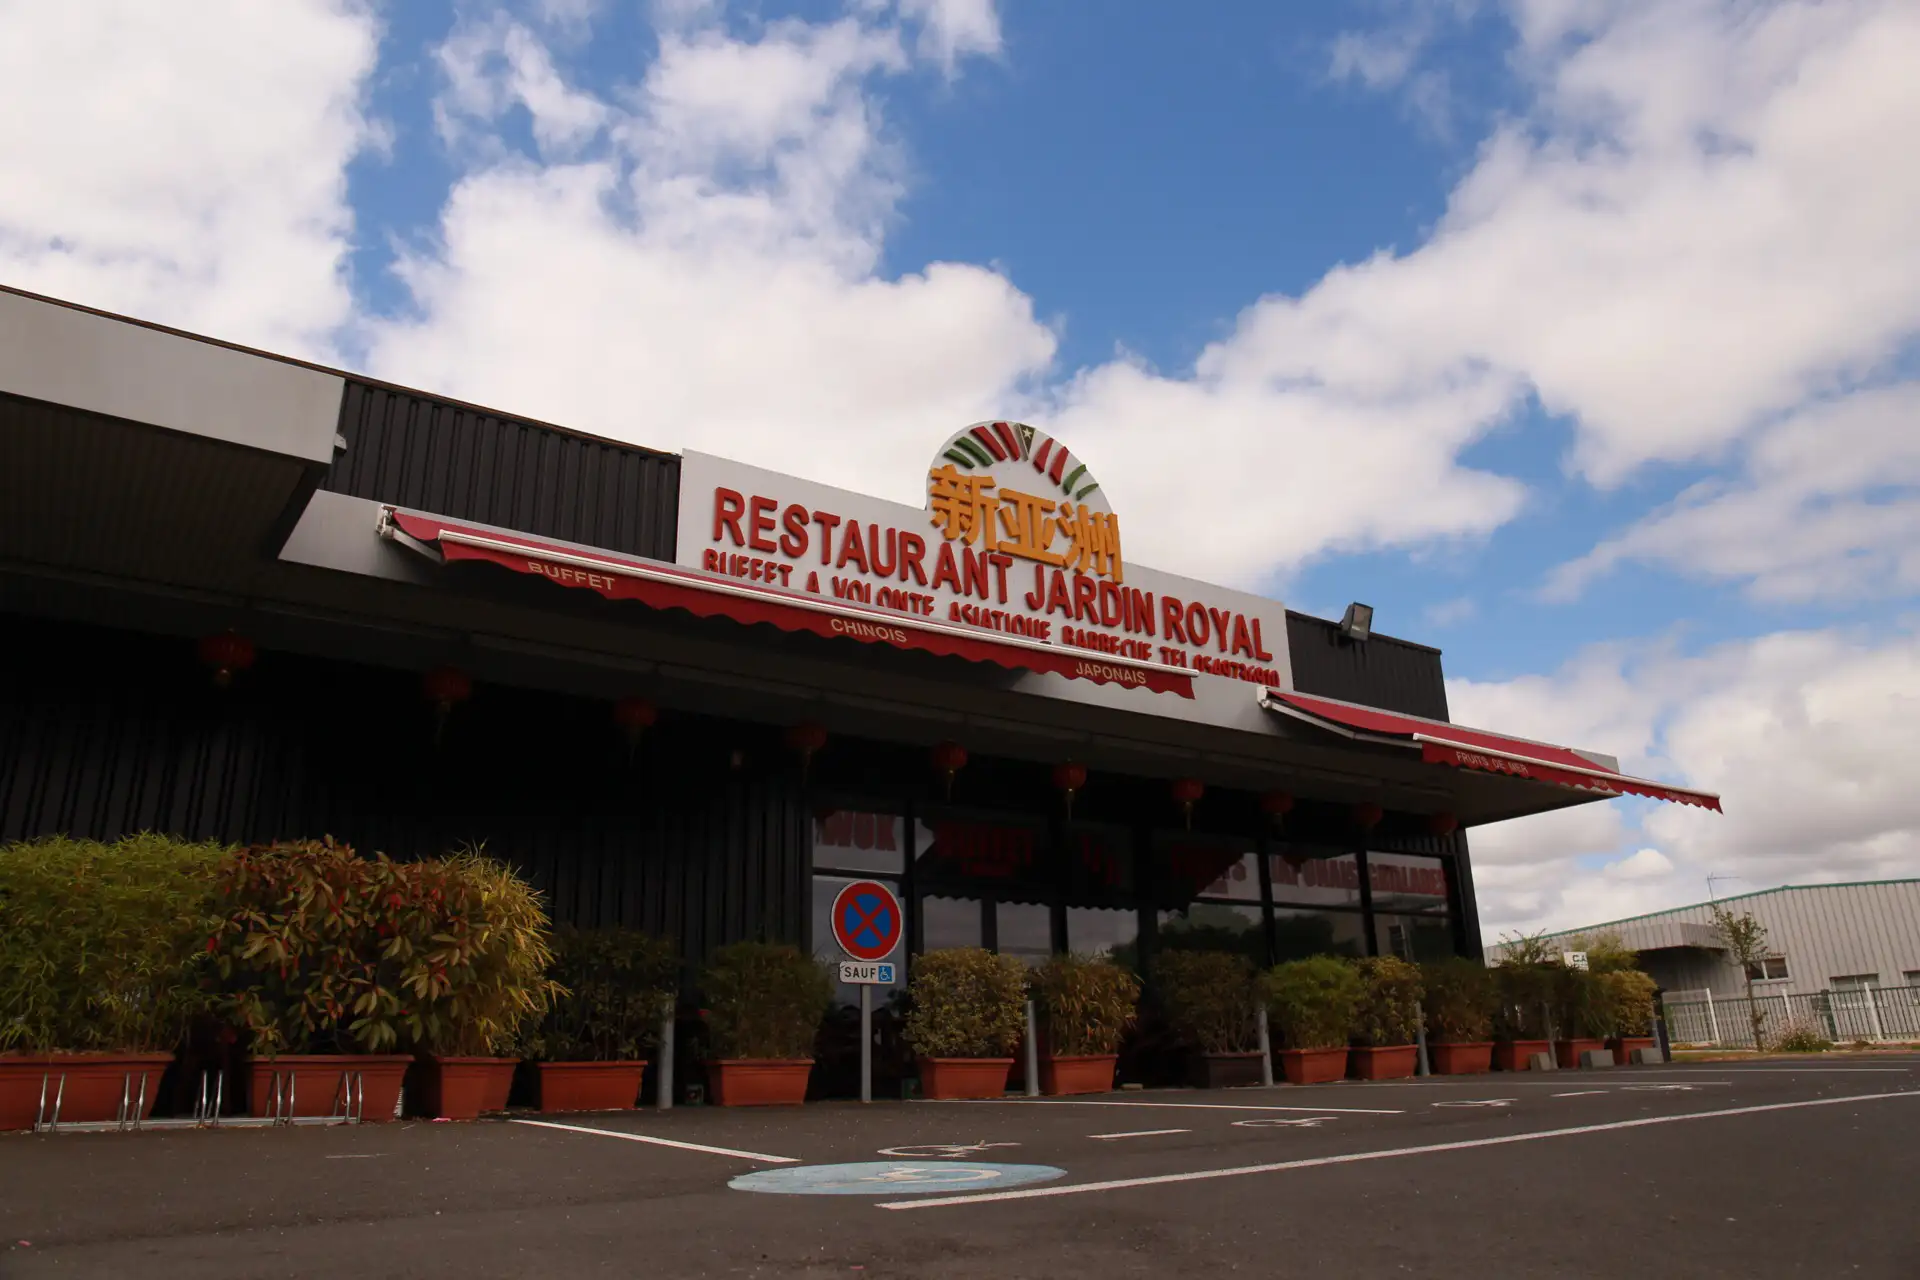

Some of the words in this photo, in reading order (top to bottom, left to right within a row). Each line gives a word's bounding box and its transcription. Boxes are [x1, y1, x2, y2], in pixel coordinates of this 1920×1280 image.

[930, 464, 1123, 584] 新亚洲
[527, 561, 616, 590] BUFFET
[713, 487, 1013, 604] RESTAURANT
[1025, 564, 1156, 637] JARDIN
[1161, 596, 1273, 662] ROYAL
[703, 549, 793, 587] BUFFET
[806, 571, 821, 594] A
[948, 602, 1051, 641] ASIATIQUE
[831, 618, 908, 643] CHINOIS
[1075, 661, 1147, 685] JAPONAIS
[1455, 751, 1489, 767] FRUITS
[844, 966, 877, 979] SAUF
